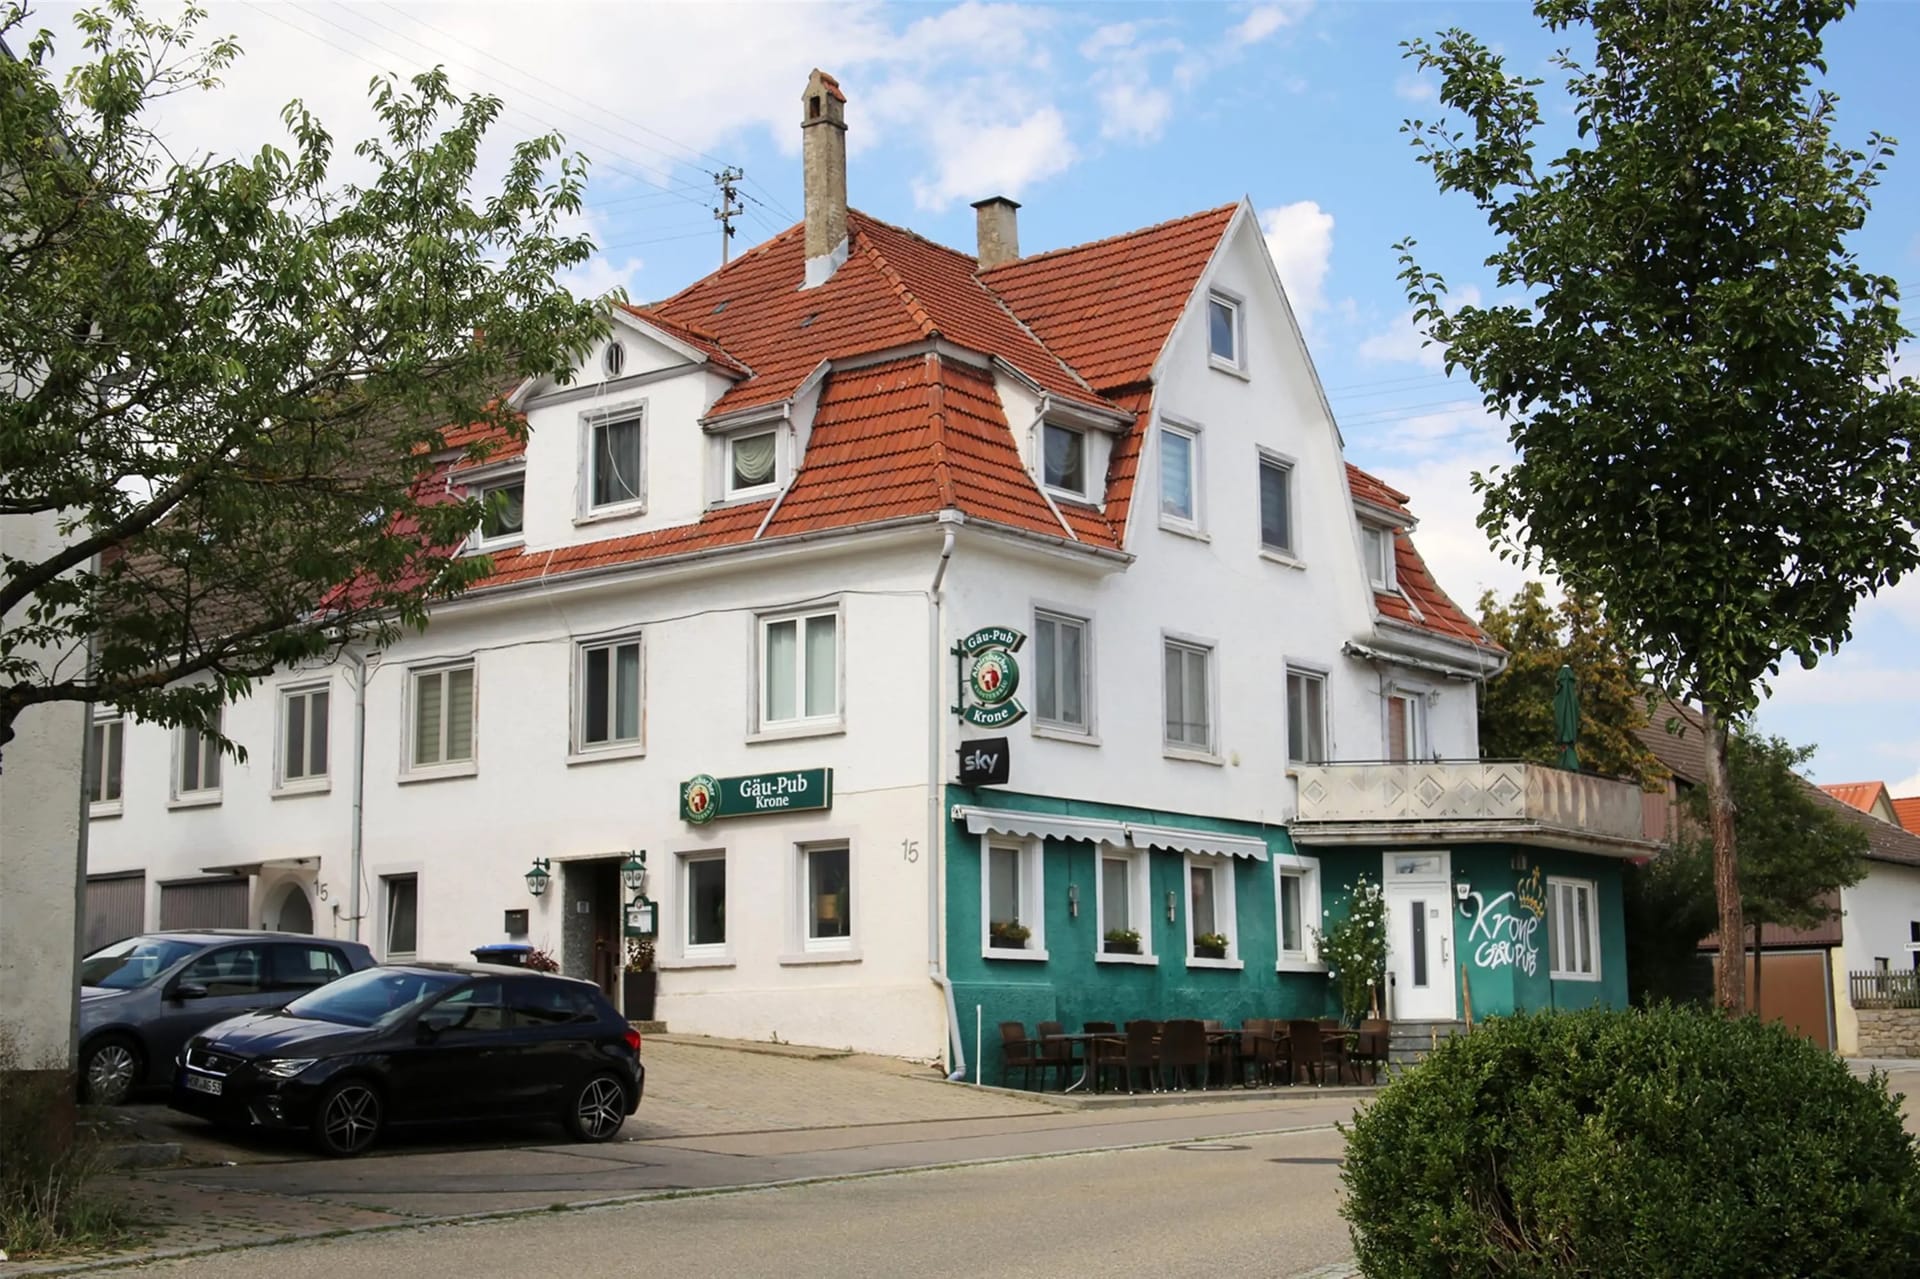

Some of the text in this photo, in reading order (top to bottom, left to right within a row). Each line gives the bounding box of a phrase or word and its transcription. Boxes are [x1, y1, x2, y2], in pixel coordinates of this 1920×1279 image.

[967, 630, 1014, 648] Gäu-Pub
[973, 708, 1009, 723] Krone
[964, 749, 999, 774] sky
[739, 773, 808, 798] Gäu-Pub
[755, 796, 789, 809] Krone
[901, 838, 919, 863] 15
[313, 879, 329, 902] 15
[1459, 891, 1539, 953] Krone
